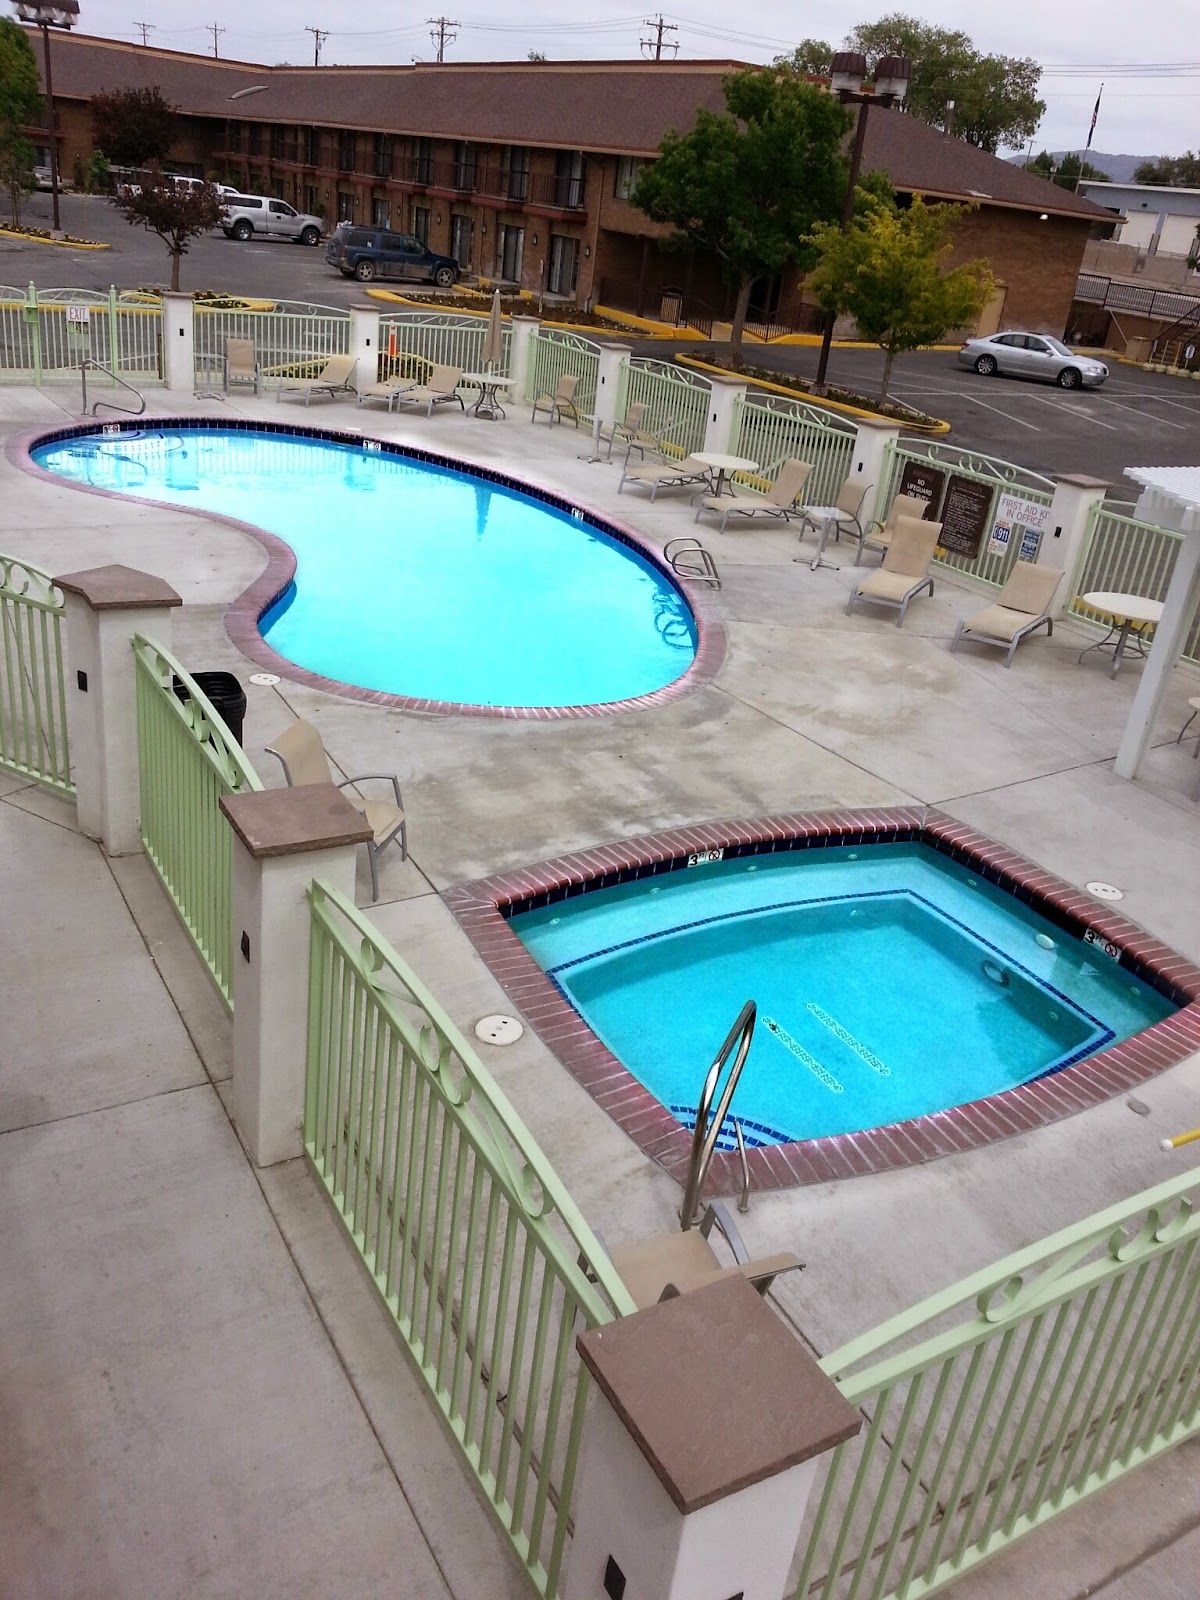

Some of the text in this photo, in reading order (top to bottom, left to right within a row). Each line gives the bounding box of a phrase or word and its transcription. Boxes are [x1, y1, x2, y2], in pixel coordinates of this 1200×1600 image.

[70, 306, 86, 320] EXIT
[906, 483, 933, 496] LIFEGUARD
[1002, 498, 1023, 510] FIRST
[1025, 505, 1038, 515] AID
[1007, 509, 1014, 518] IN
[1017, 512, 1043, 527] OFFICE
[998, 529, 1009, 542] 911
[690, 855, 698, 865] 3
[1085, 931, 1095, 943] 3
